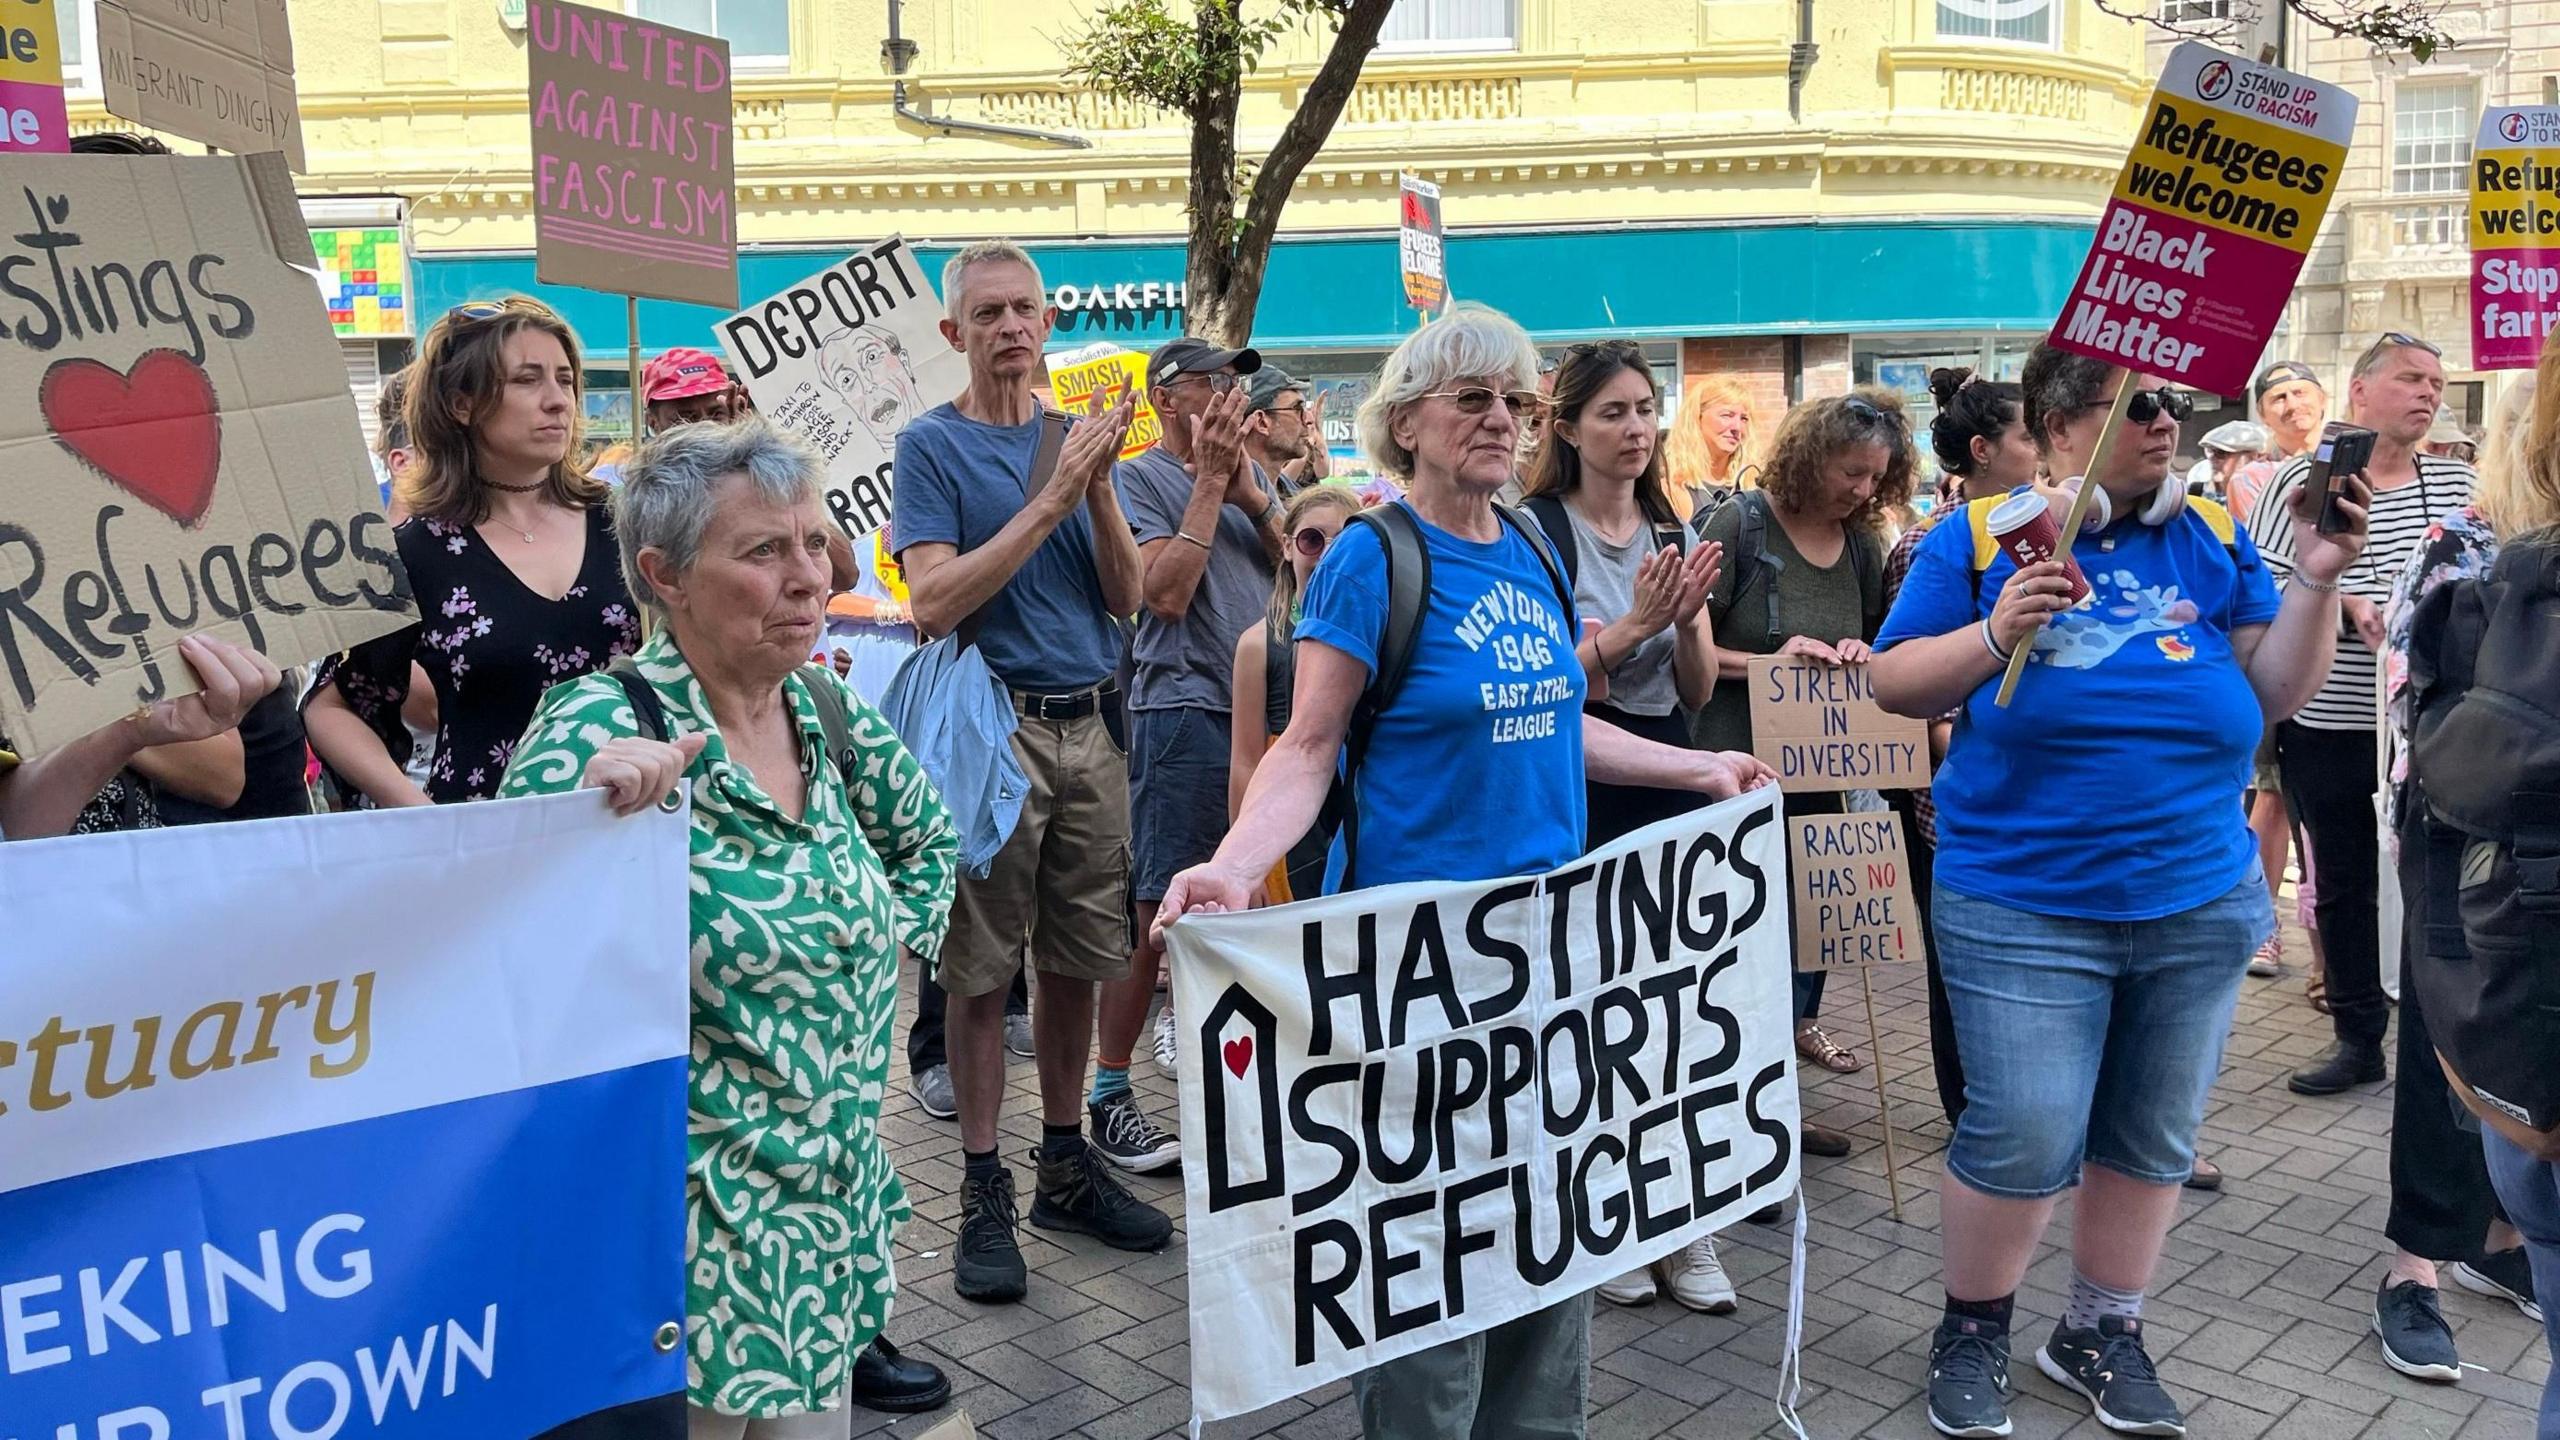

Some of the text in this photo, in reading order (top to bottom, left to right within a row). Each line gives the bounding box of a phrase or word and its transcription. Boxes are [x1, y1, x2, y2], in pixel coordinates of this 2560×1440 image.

[530, 3, 728, 93] UNITED
[107, 47, 291, 142] MIGRANT DINGHY
[2239, 72, 2317, 105] STAND UP
[534, 80, 727, 172] AGAINST
[2233, 90, 2318, 128] TO RACISM
[2144, 102, 2329, 196] Refugees
[2532, 128, 2548, 142] TO
[537, 153, 729, 244] FASCISM
[2128, 162, 2300, 239] welcome
[2101, 207, 2215, 278] Black
[2083, 254, 2189, 320] Lives
[2481, 258, 2559, 303] Stop
[725, 238, 917, 380] DEPORT
[2481, 302, 2536, 340] far
[2063, 299, 2206, 374] Matter
[1057, 360, 1124, 398] SMASH
[803, 404, 822, 424] FOR
[820, 432, 839, 454] AND
[1492, 633, 1553, 673] 1946
[1480, 675, 1574, 711] EAST ATHL.
[1492, 711, 1556, 743] LEAGUE
[1823, 706, 1848, 737] IN
[1782, 743, 1917, 778] DIVERSITY
[1803, 820, 1897, 858] RACISM
[1808, 862, 1896, 900] HAS NO
[1302, 804, 1775, 1058] HASTINGS
[1819, 896, 1897, 933] PLACE
[1821, 926, 1905, 965] HERE!
[1287, 945, 1742, 1217] SUPPORTS
[1293, 1060, 1792, 1368] REFUGEES
[201, 1302, 498, 1440] TOWN
